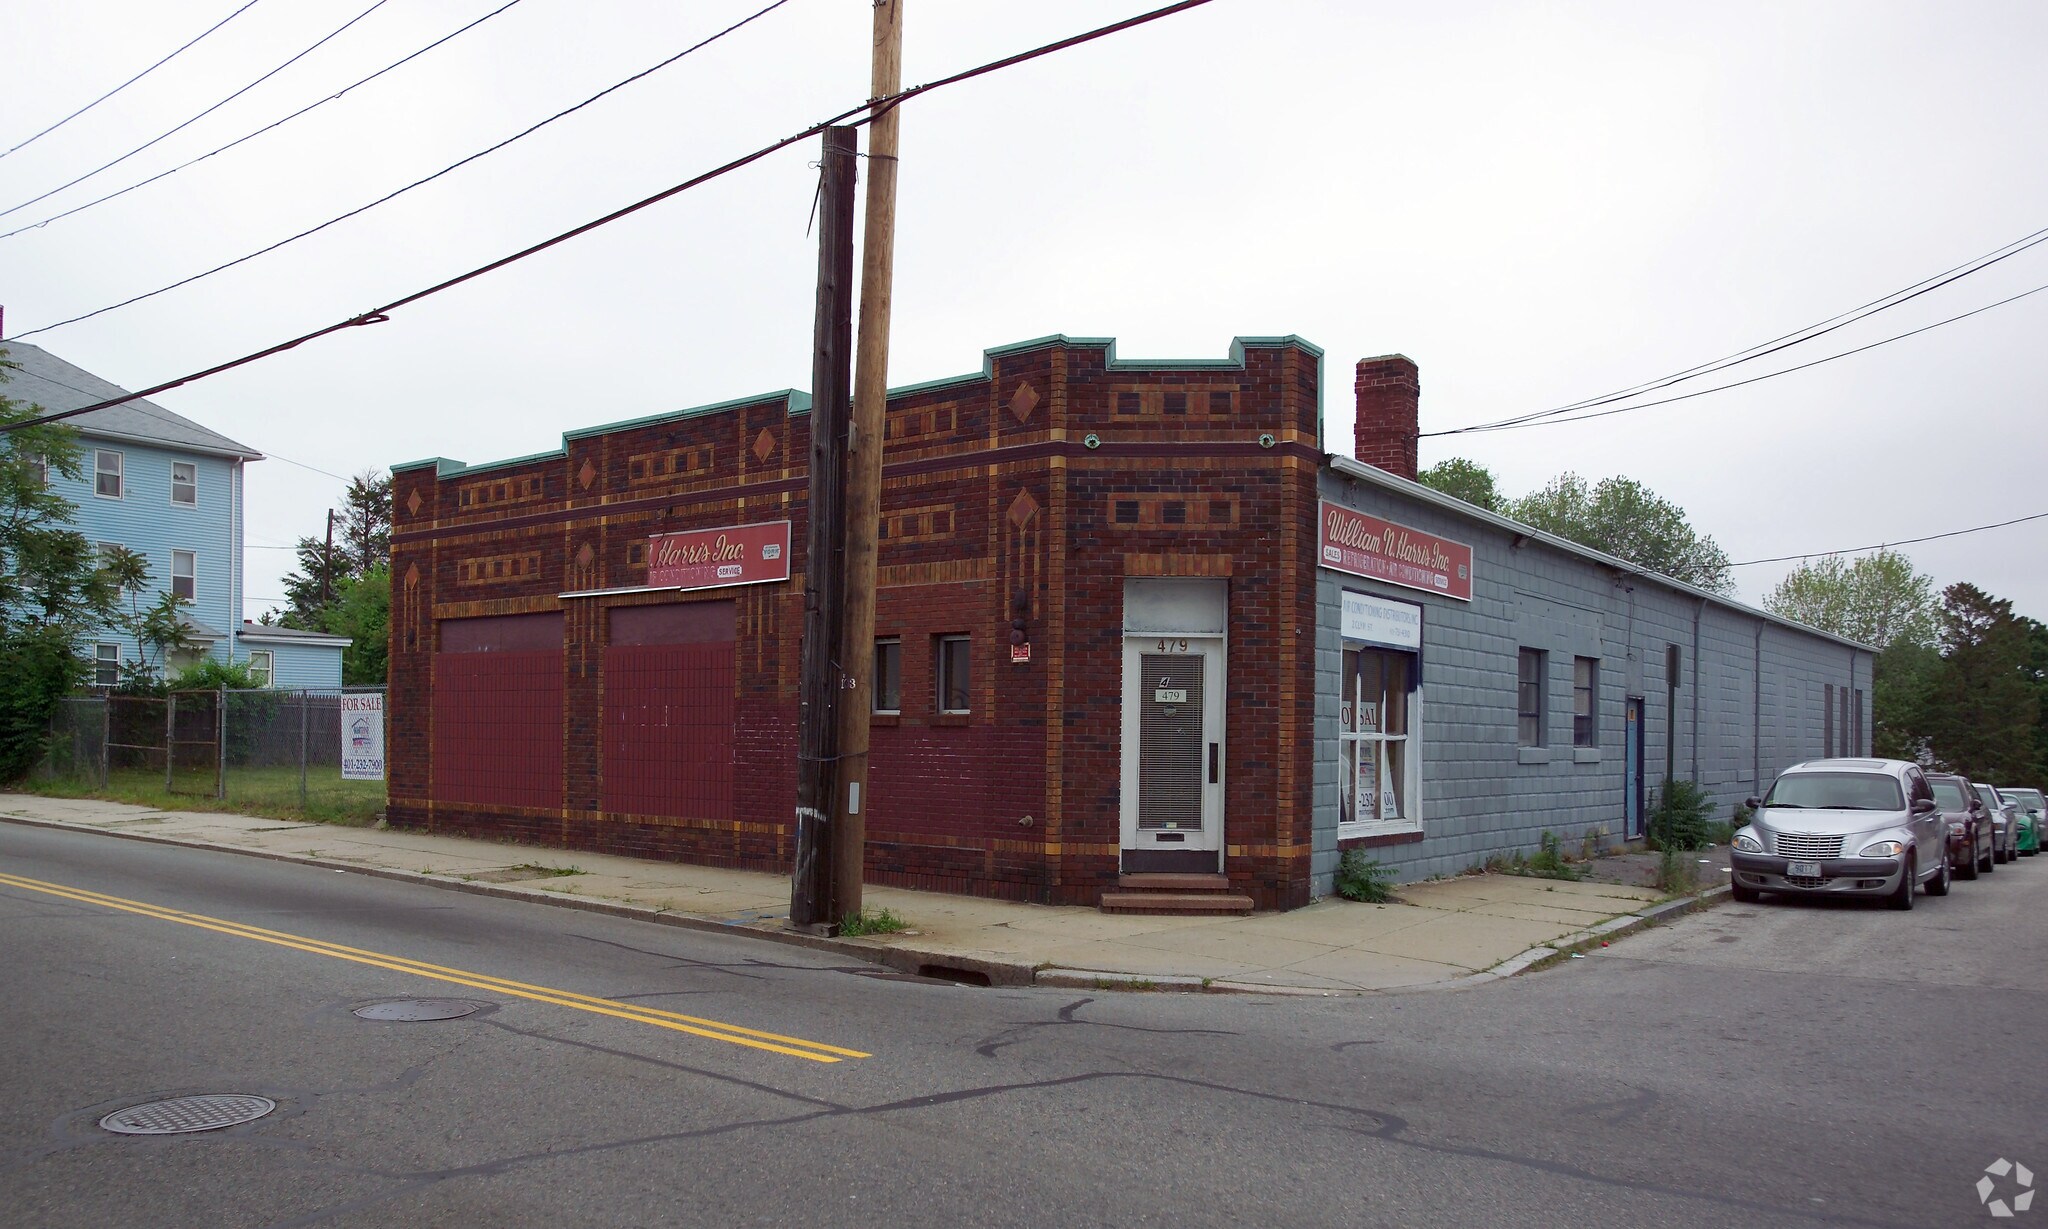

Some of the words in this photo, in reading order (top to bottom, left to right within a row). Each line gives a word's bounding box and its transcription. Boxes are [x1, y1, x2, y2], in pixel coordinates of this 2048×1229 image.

[1327, 510, 1381, 554] William
[1383, 527, 1396, 557] N.
[1395, 531, 1432, 566] Harris
[1431, 542, 1450, 573] Inc.
[656, 539, 711, 567] Harris
[711, 534, 744, 562] Inc.
[1325, 548, 1341, 560] SALES
[718, 566, 741, 576] SERVICE
[1342, 549, 1387, 574] REFRIGERATION
[1398, 564, 1434, 586] CONDITIONING
[1157, 639, 1188, 653] 479
[1160, 677, 1169, 687] 4
[1162, 691, 1180, 701] 479
[342, 697, 359, 711] FOR
[360, 697, 382, 711] SALE
